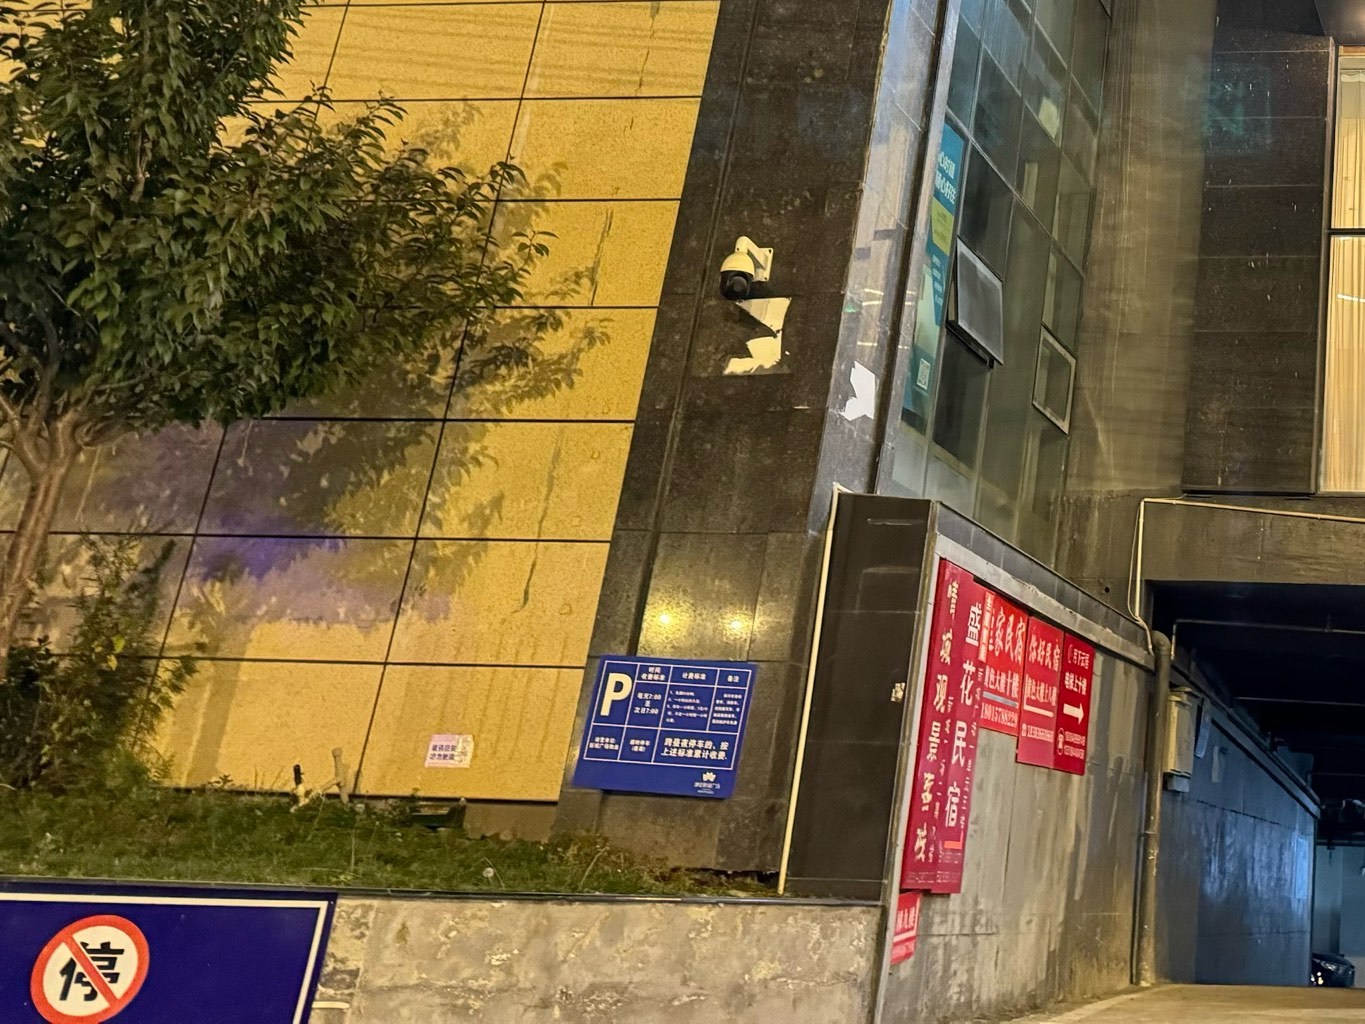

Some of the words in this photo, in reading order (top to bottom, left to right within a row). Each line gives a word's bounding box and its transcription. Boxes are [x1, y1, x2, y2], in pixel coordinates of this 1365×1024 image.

[600, 673, 632, 716] P
[945, 602, 982, 828] 盛花民宿
[59, 941, 124, 1001] 停
